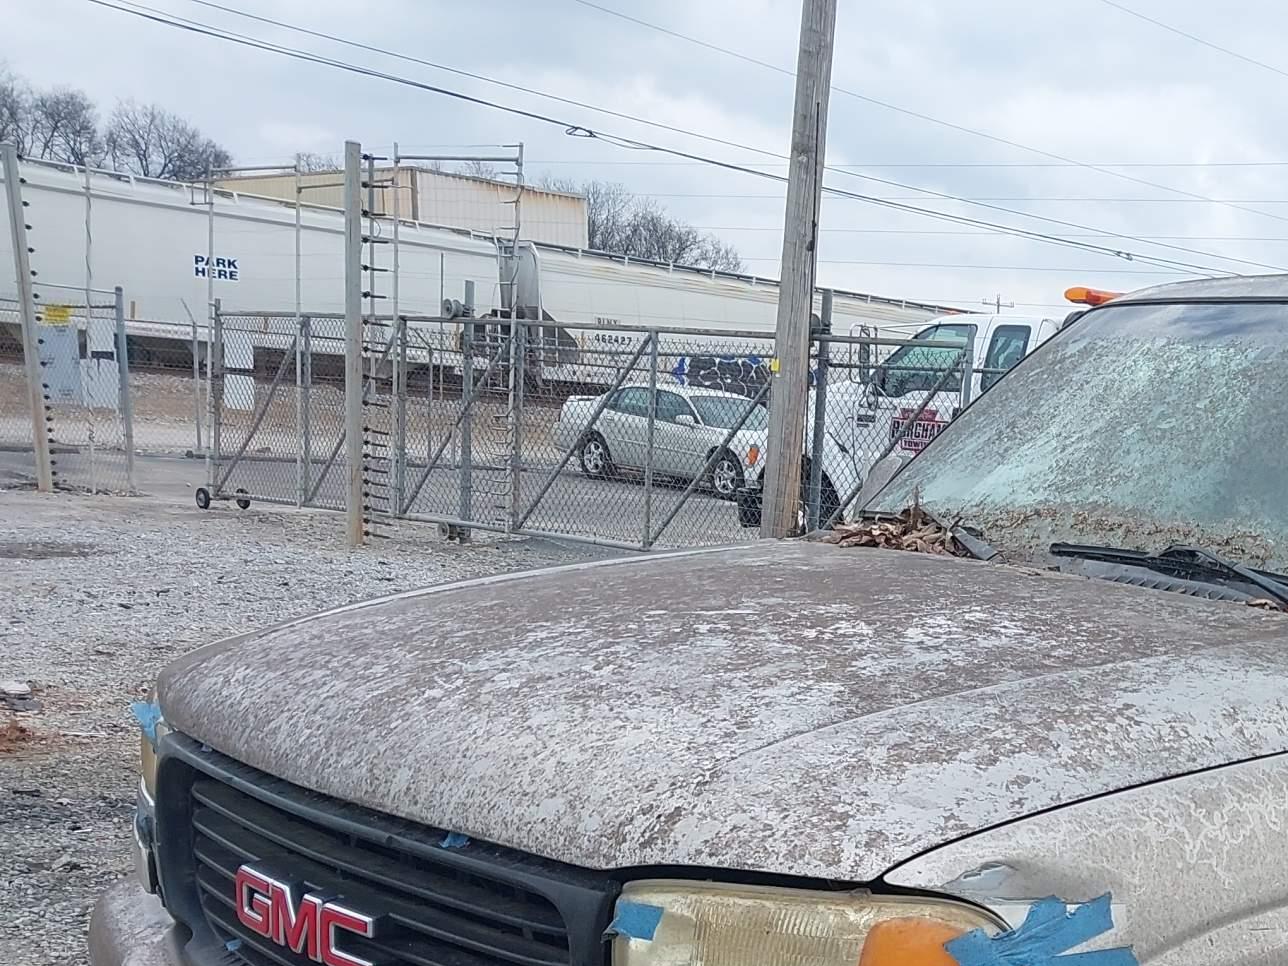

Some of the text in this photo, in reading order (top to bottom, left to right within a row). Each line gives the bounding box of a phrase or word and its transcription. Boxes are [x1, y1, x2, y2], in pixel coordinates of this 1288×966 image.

[194, 255, 238, 269] PARK
[194, 267, 239, 281] HERE
[594, 333, 632, 346] 462427
